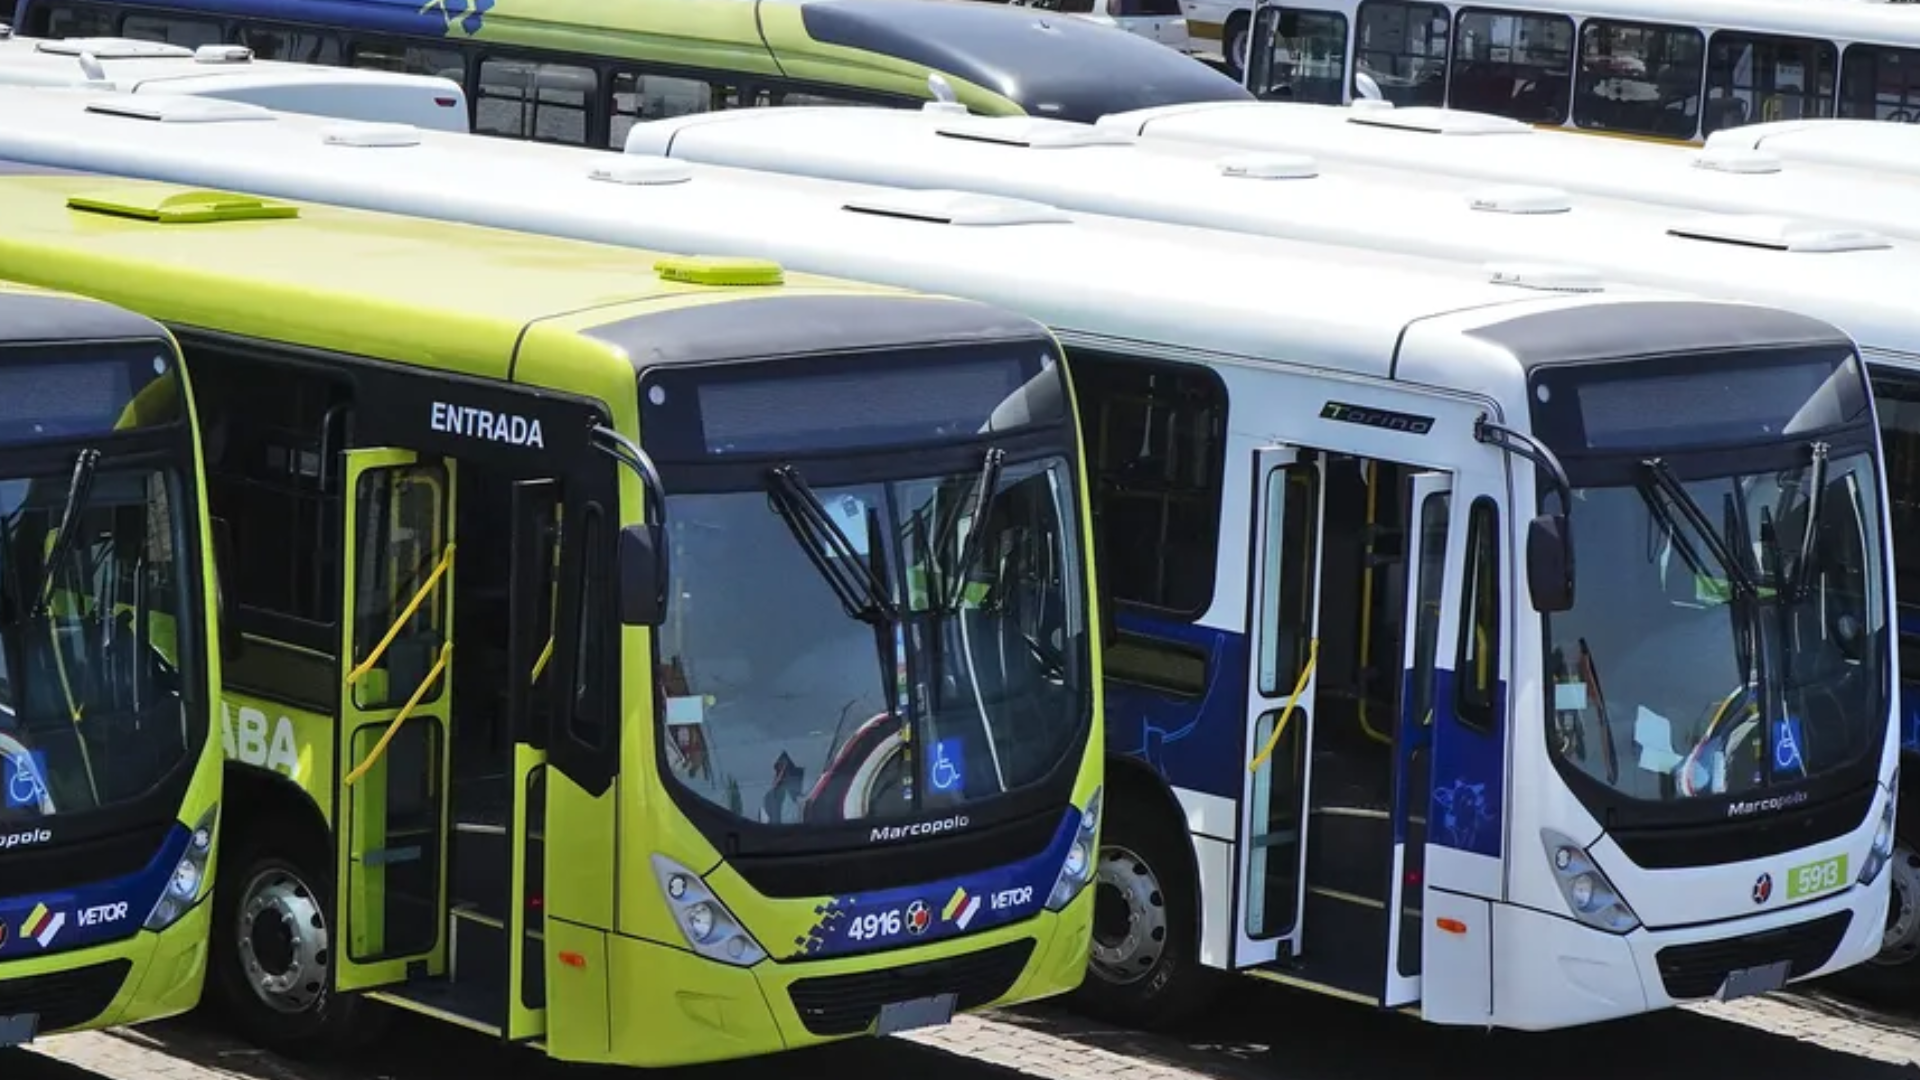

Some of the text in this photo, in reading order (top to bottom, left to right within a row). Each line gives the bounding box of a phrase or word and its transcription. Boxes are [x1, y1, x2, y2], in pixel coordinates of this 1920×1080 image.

[431, 401, 544, 448] ENTRADA
[1328, 404, 1428, 433] Torino
[1727, 791, 1807, 817] Marcopolo
[870, 814, 969, 842] Marcopolo
[1798, 860, 1838, 893] 5913
[77, 901, 128, 927] VETOR
[848, 886, 1033, 940] 4916 VETOR
